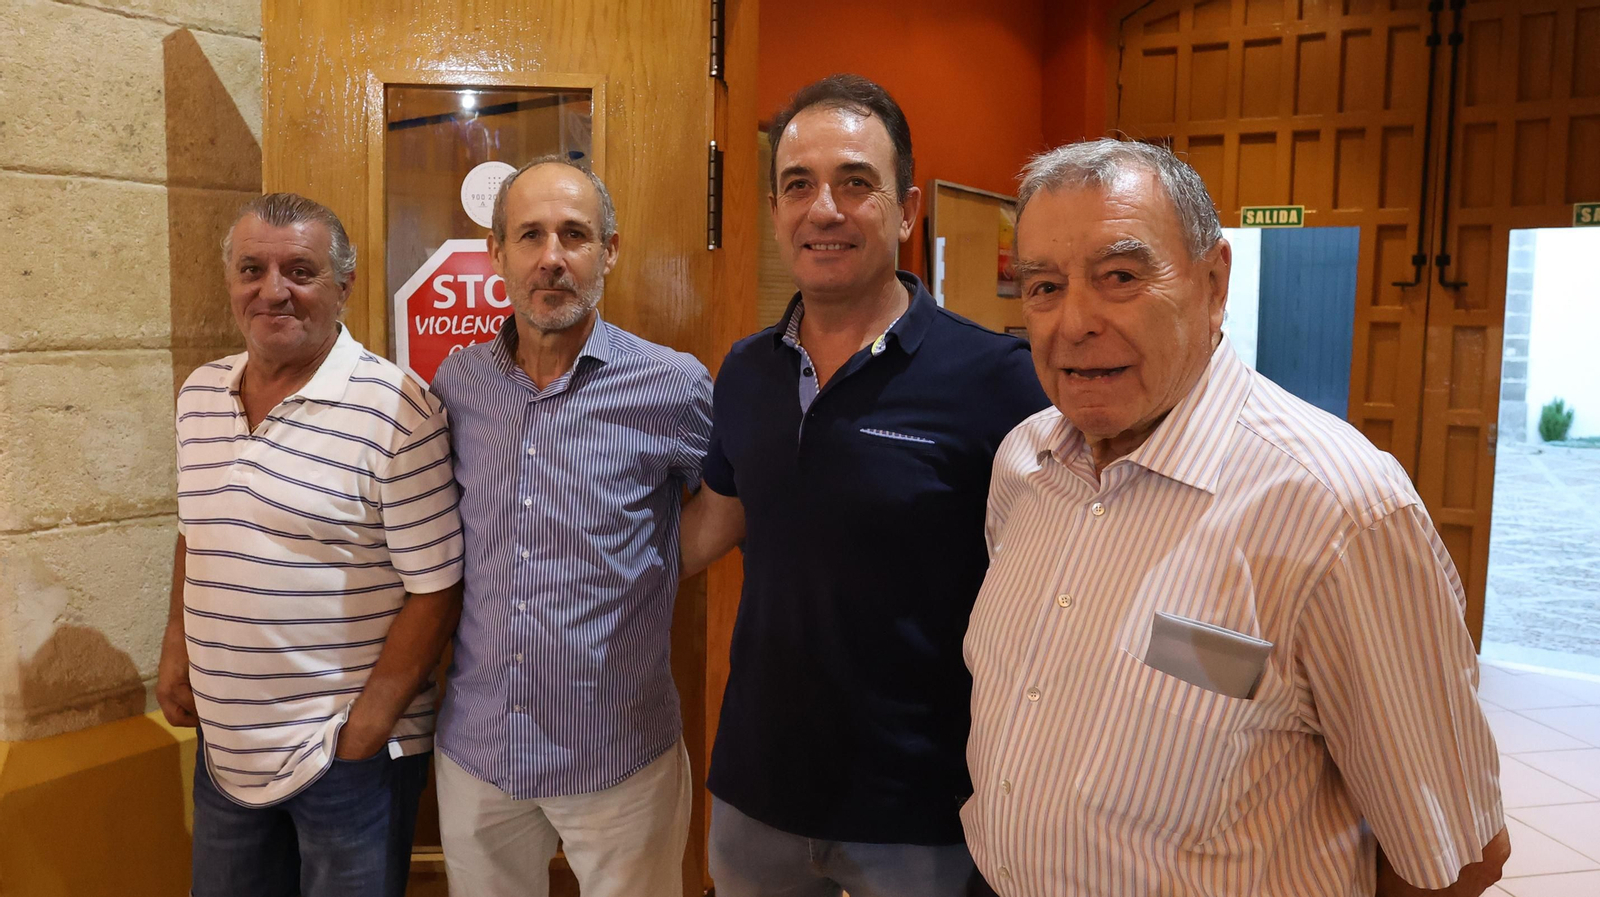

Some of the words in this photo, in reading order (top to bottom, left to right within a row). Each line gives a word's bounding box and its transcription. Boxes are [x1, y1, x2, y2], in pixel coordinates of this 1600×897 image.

[1246, 210, 1298, 224] SALIDA
[1581, 207, 1600, 222] SA
[432, 274, 511, 309] STO
[415, 315, 509, 335] VIOLENC
